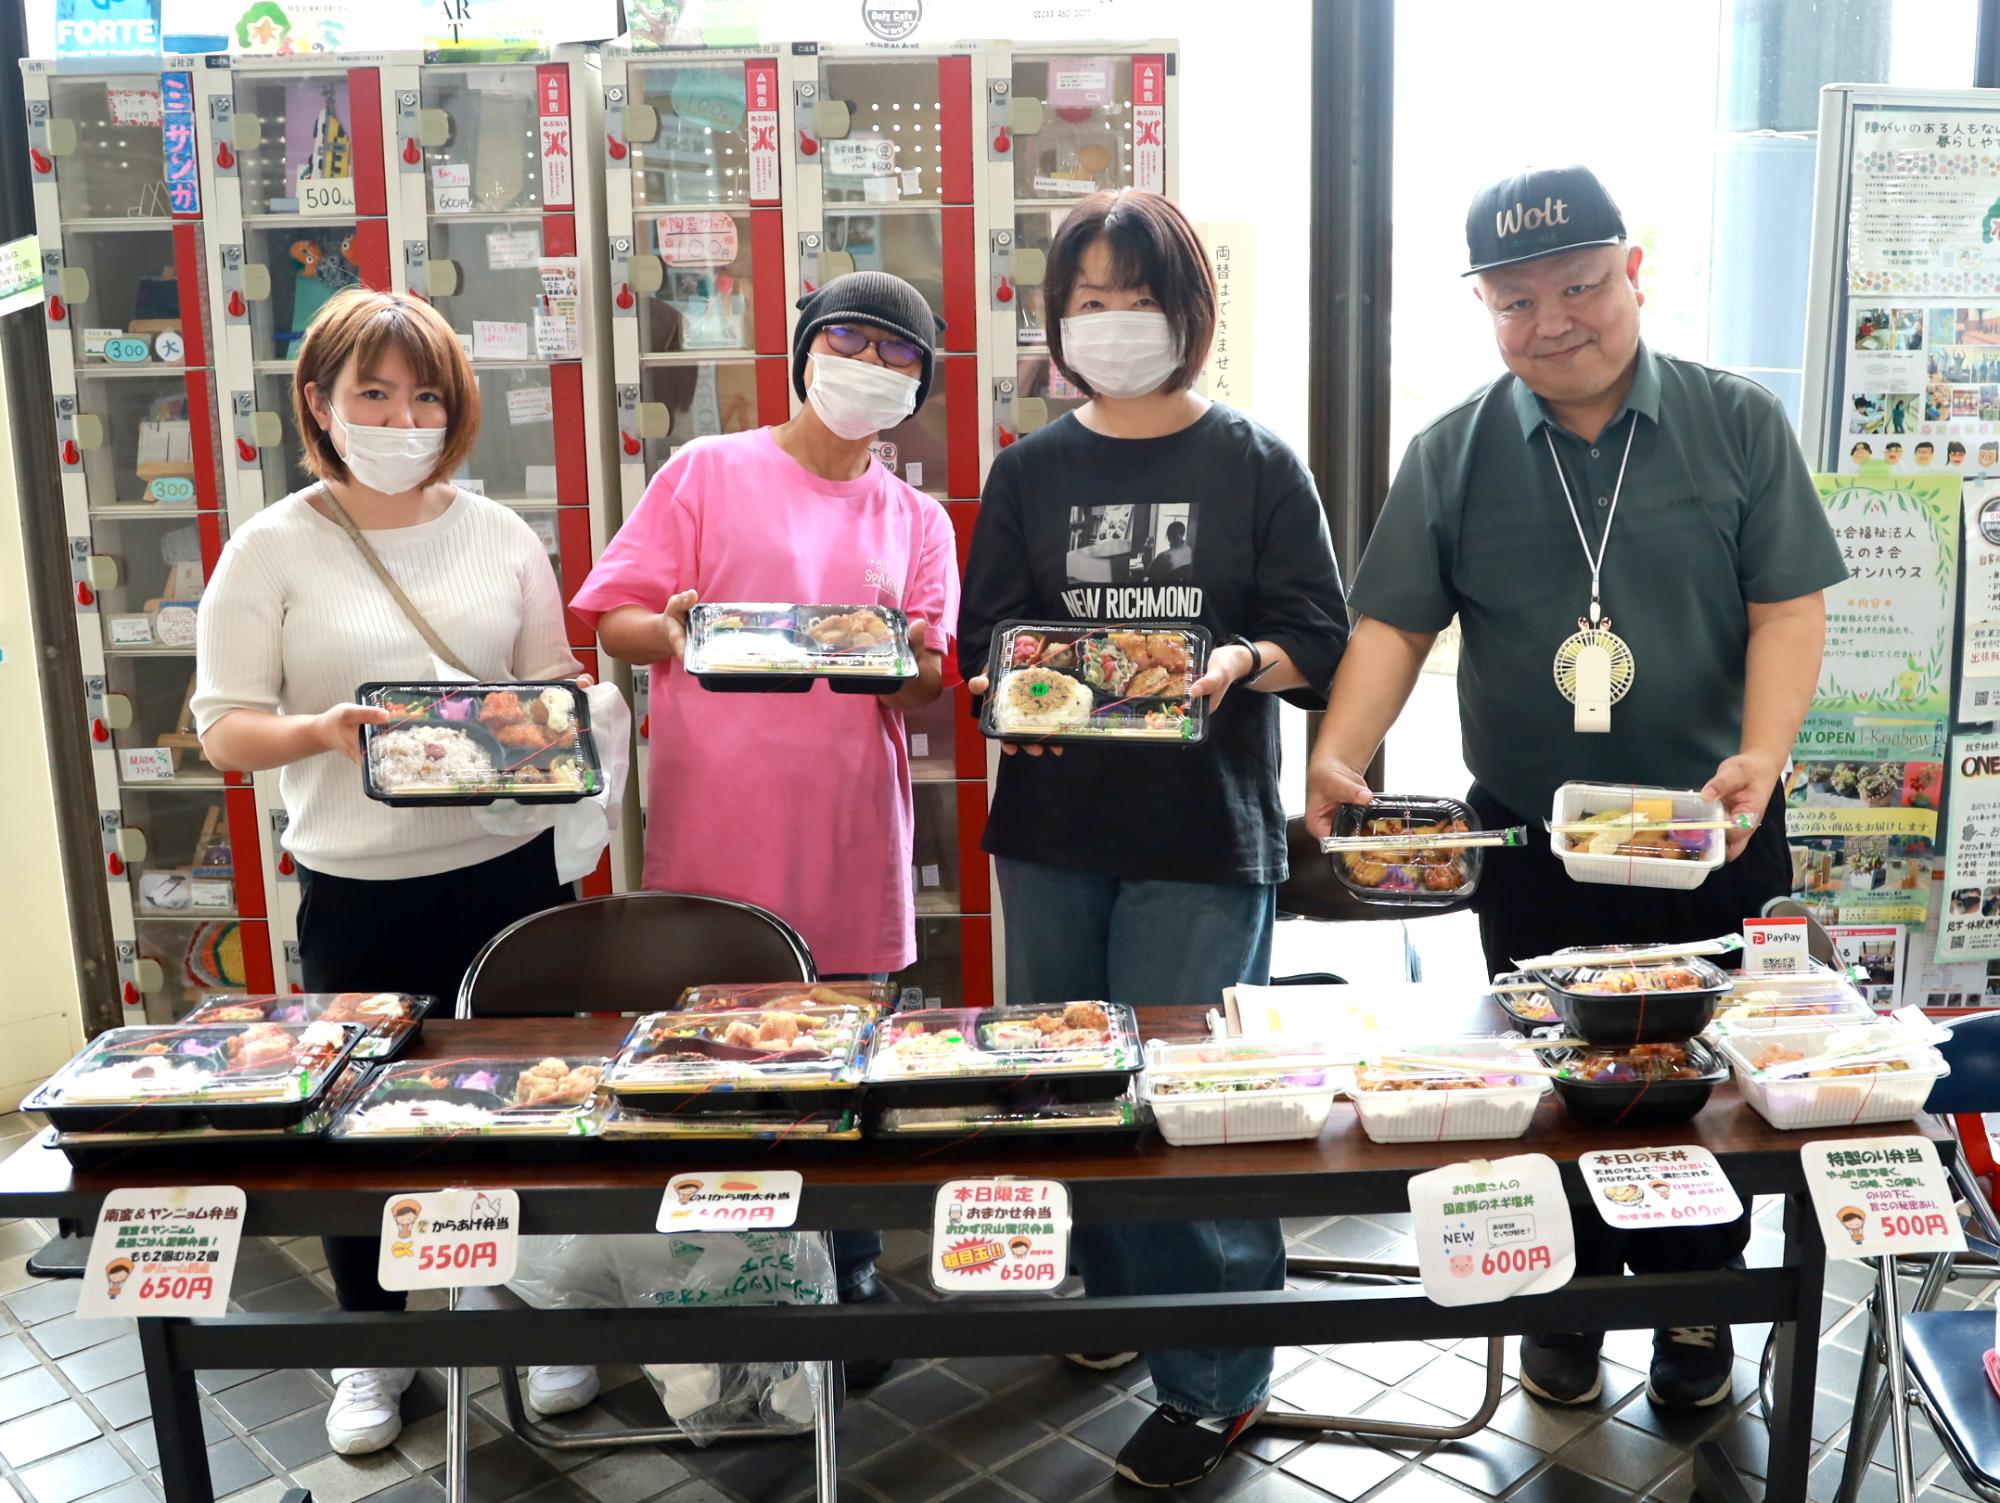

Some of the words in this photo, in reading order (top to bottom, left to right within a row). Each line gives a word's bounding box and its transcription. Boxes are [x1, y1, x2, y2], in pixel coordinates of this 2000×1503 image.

[57, 19, 157, 45] FORTE
[164, 79, 193, 209] ミサンガ
[1496, 197, 1570, 239] Wolt
[1215, 245, 1232, 397] 両替はできません。
[111, 340, 144, 359] 300
[155, 480, 189, 498] 300
[1844, 546, 1902, 559] えのき会
[1850, 566, 1922, 579] オンハウス
[1061, 587, 1100, 619] NEW
[1105, 585, 1203, 619] RICHMOND
[1818, 717, 1843, 727] Shop
[1815, 731, 1855, 744] OPEN
[1786, 821, 1929, 834] 感の高い商品をお届けします
[1767, 932, 1801, 943] PayPay
[1594, 1150, 1689, 1166] 本日の天丼
[1826, 1148, 1923, 1168] 特製のり弁当
[954, 1186, 1048, 1203] 本日限定！
[1452, 1179, 1521, 1196] お肉屋さんの
[966, 1206, 1052, 1220] おまかせ弁当
[1443, 1194, 1536, 1216] 国産豚のネギ塩丼
[431, 1216, 510, 1233] からあげ弁当
[1881, 1214, 1950, 1237] 500円
[1443, 1231, 1475, 1245] NEW
[418, 1241, 497, 1271] 550円
[1481, 1244, 1552, 1277] 600円
[1000, 1263, 1055, 1281] 650円
[138, 1275, 214, 1301] 650円
